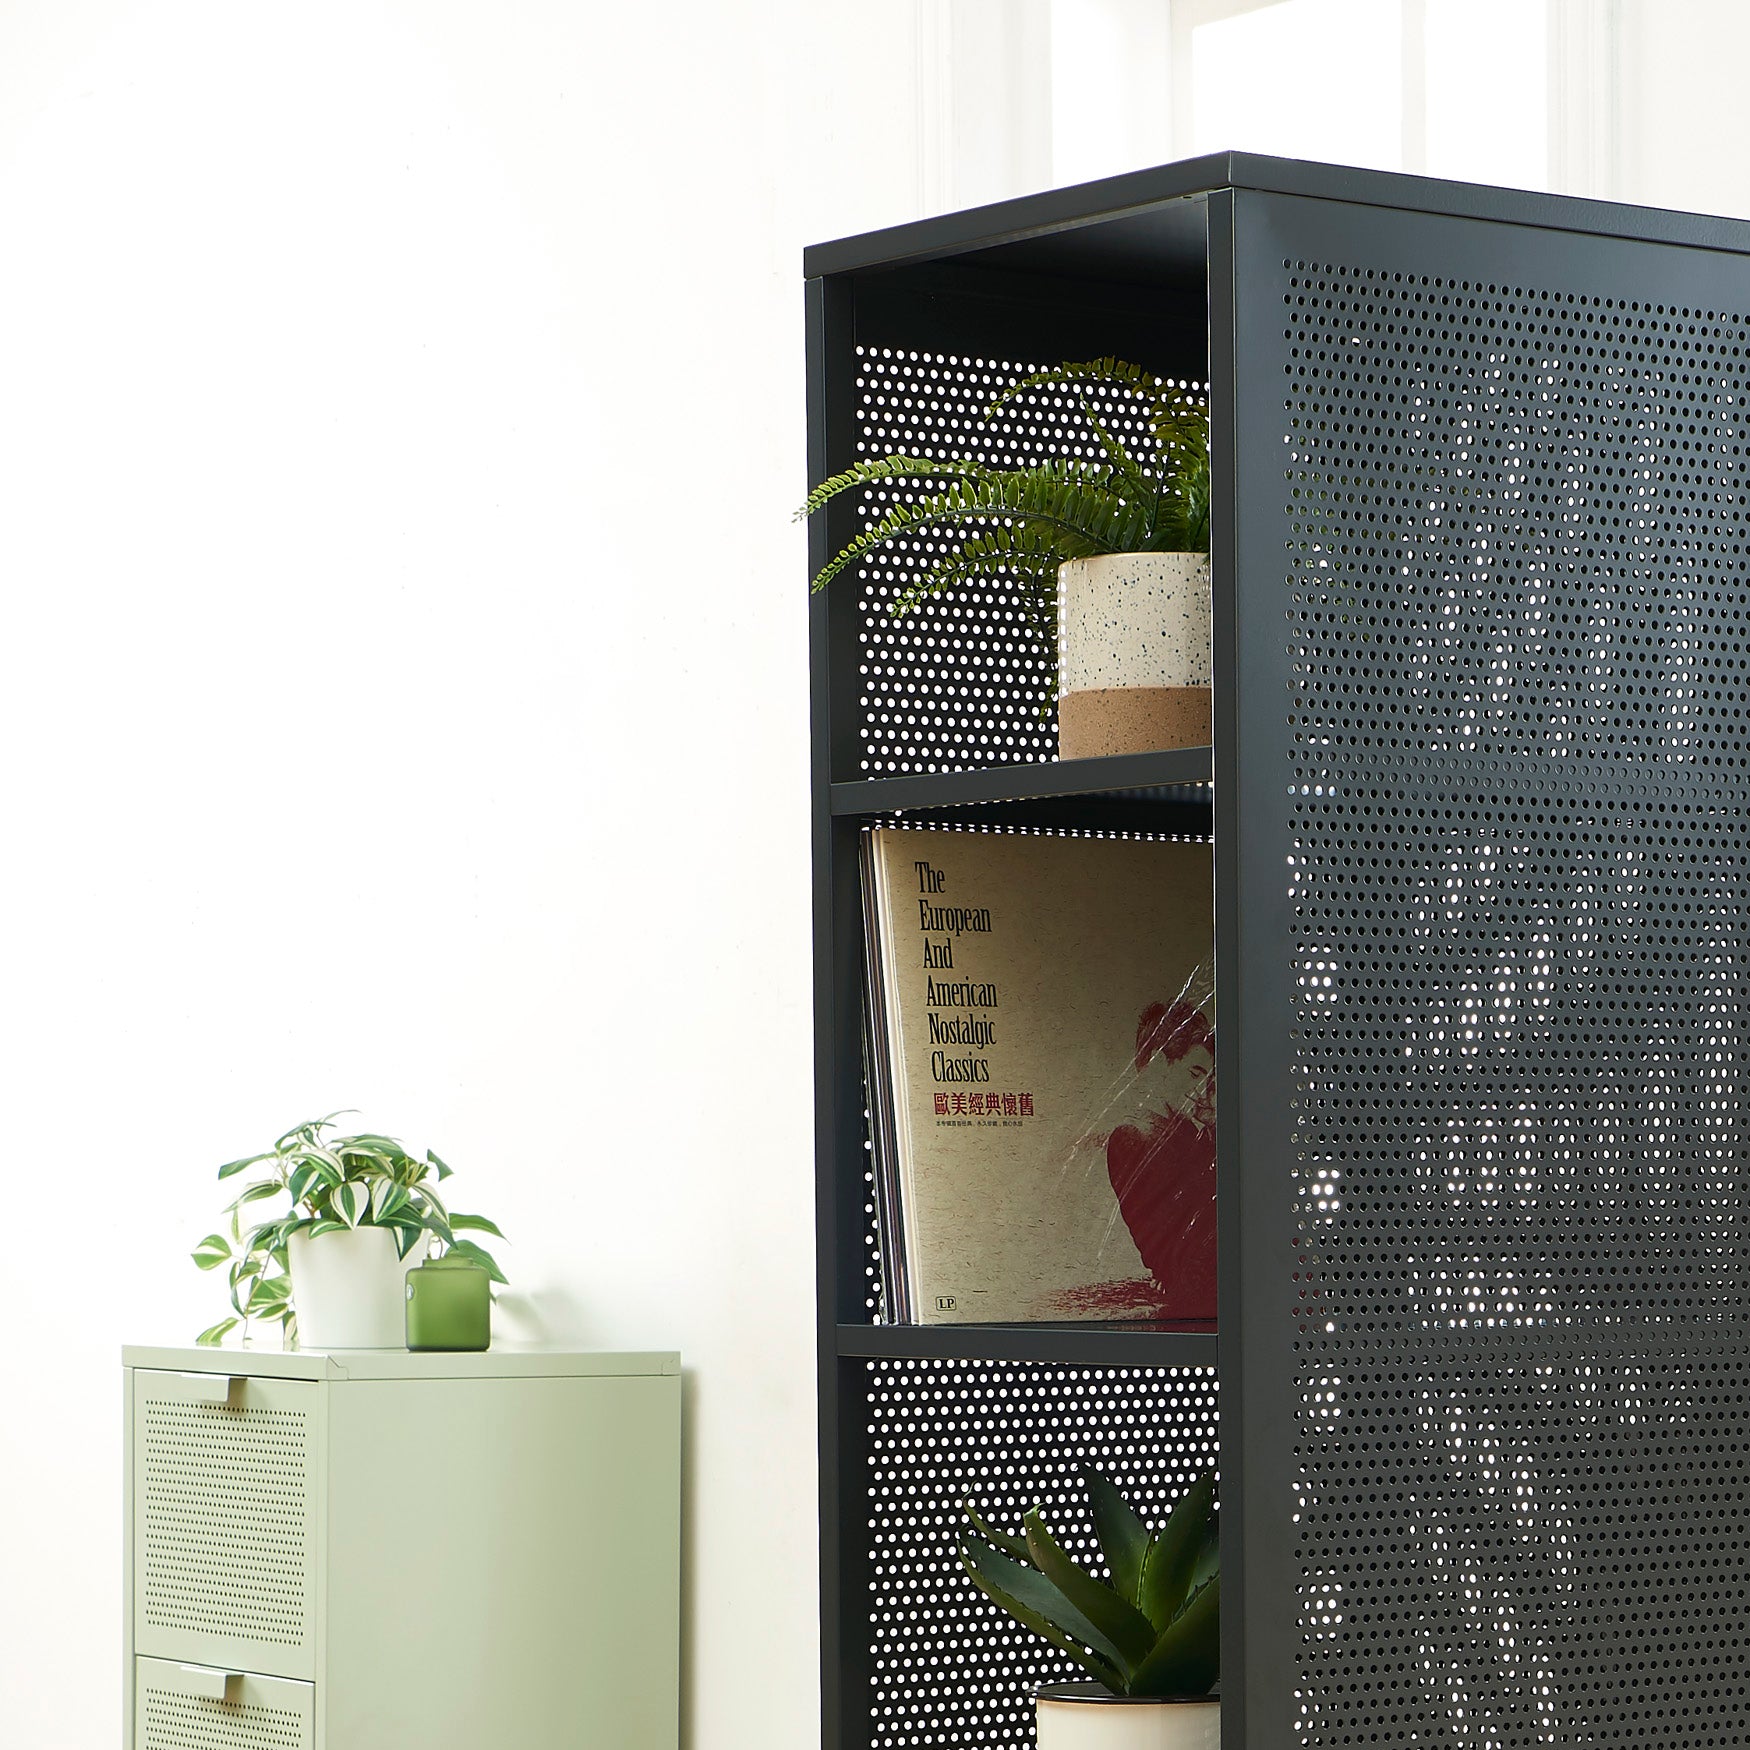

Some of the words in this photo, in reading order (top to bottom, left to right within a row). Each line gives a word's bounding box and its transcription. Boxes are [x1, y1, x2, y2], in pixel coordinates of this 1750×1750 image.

[914, 862, 946, 894] The
[918, 899, 993, 937] European
[923, 937, 954, 969] And
[926, 975, 999, 1008] American
[927, 1013, 997, 1050] Nostalgic
[931, 1050, 990, 1082] Classics
[933, 1092, 1035, 1117] 歐美經典懷舊
[939, 1298, 955, 1309] LP
